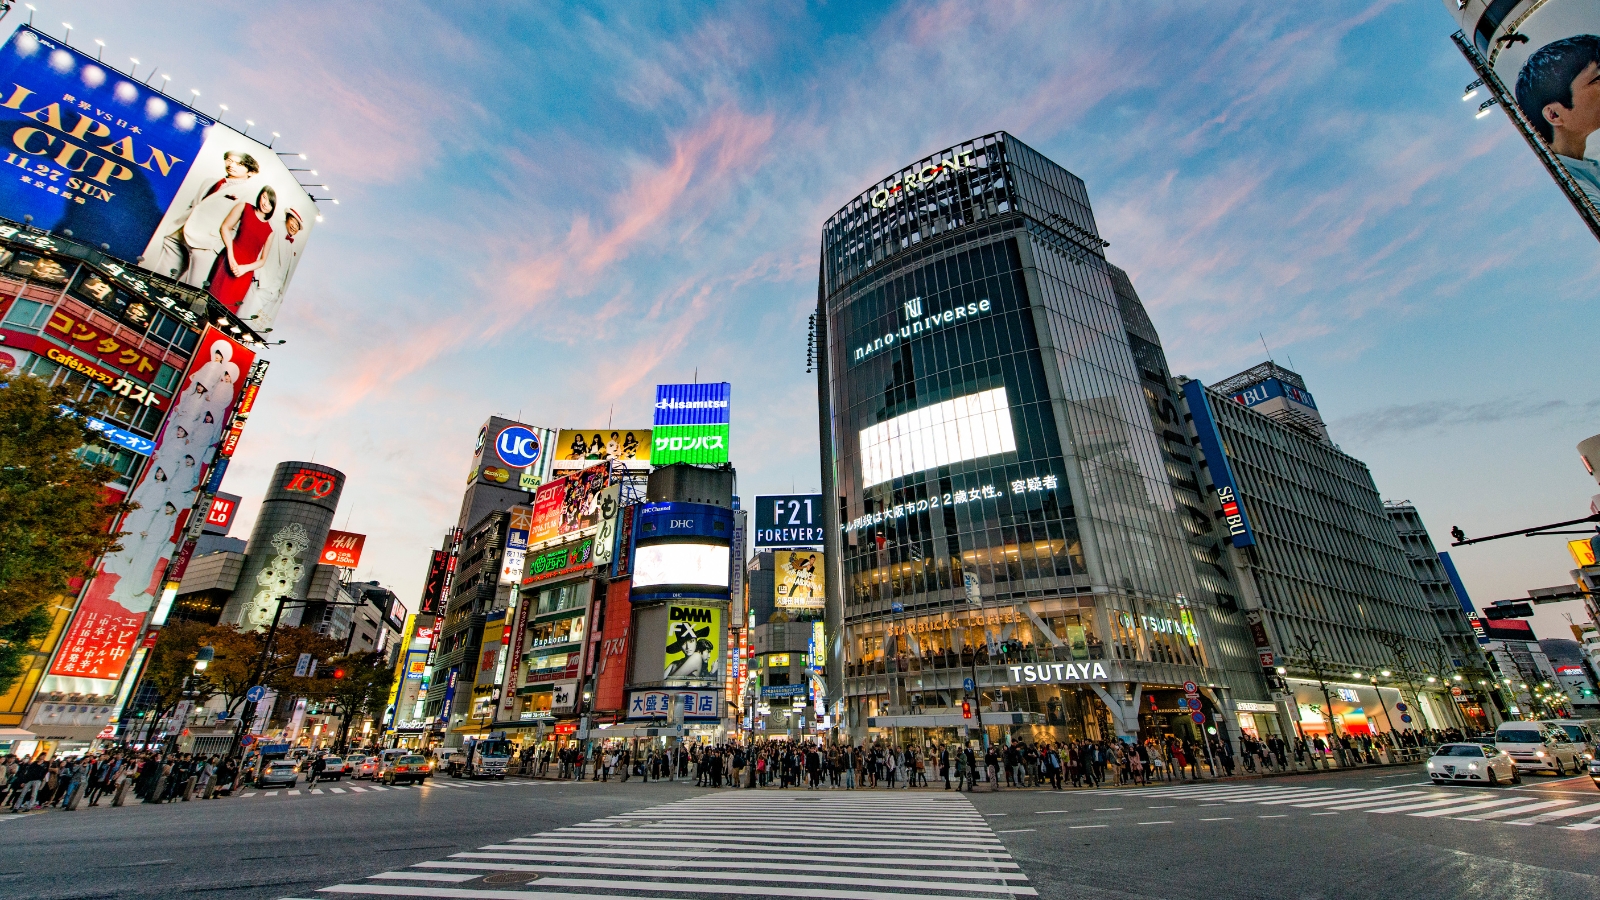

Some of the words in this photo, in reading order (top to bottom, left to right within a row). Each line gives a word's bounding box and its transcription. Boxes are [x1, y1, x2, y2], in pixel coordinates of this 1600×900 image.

[63, 93, 92, 110] 世界
[96, 108, 113, 122] VS
[116, 118, 143, 135] 日本
[0, 82, 185, 177] JAPAN
[12, 126, 134, 187] CUP
[3, 152, 64, 181] 11.27
[65, 176, 116, 203] SUN
[48, 310, 155, 375] コンタクト
[111, 377, 161, 407] ガスト
[661, 398, 728, 409] Hisamitsu
[655, 436, 724, 451] サロンパス
[299, 468, 336, 482] SHIBUYA
[522, 478, 540, 486] VISA
[1012, 475, 1058, 494] 容疑者
[284, 473, 335, 499] 109
[511, 509, 531, 530] 本
[773, 499, 813, 525] F21
[1217, 486, 1246, 537] SEIBU
[669, 519, 694, 529] DHC
[332, 534, 358, 550] H&M
[757, 529, 813, 542] FOREVER
[670, 606, 712, 623] DMM
[887, 618, 959, 637] STARBUCKS
[968, 612, 1022, 627] COFFEE
[668, 622, 696, 638] FX
[1141, 615, 1199, 639] TSUTAYA
[88, 616, 122, 674] ベストアルバム
[110, 617, 138, 661] エビ中
[534, 634, 569, 647] Euphoria
[1262, 654, 1273, 664] 本
[1010, 662, 1108, 682] TSUTAYA
